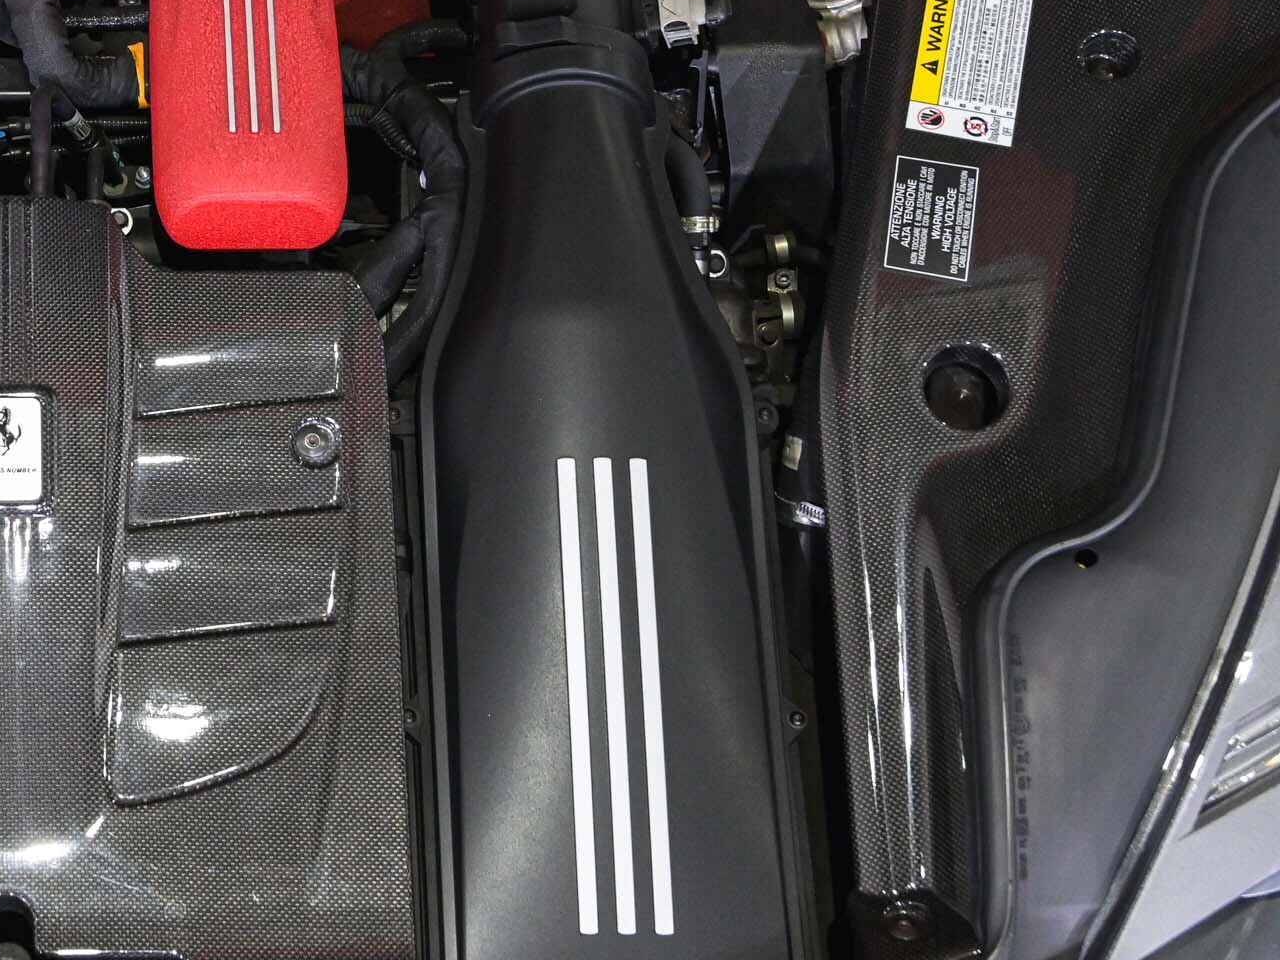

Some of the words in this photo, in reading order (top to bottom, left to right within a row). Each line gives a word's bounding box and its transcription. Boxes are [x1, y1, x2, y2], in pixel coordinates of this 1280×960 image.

[891, 182, 906, 240] ATTENZIONE
[903, 179, 917, 224] TENSIONE
[931, 196, 945, 239] WARNING
[944, 187, 957, 226] VOLTAGE
[900, 227, 911, 248] ALTA
[941, 228, 952, 252] HIGH
